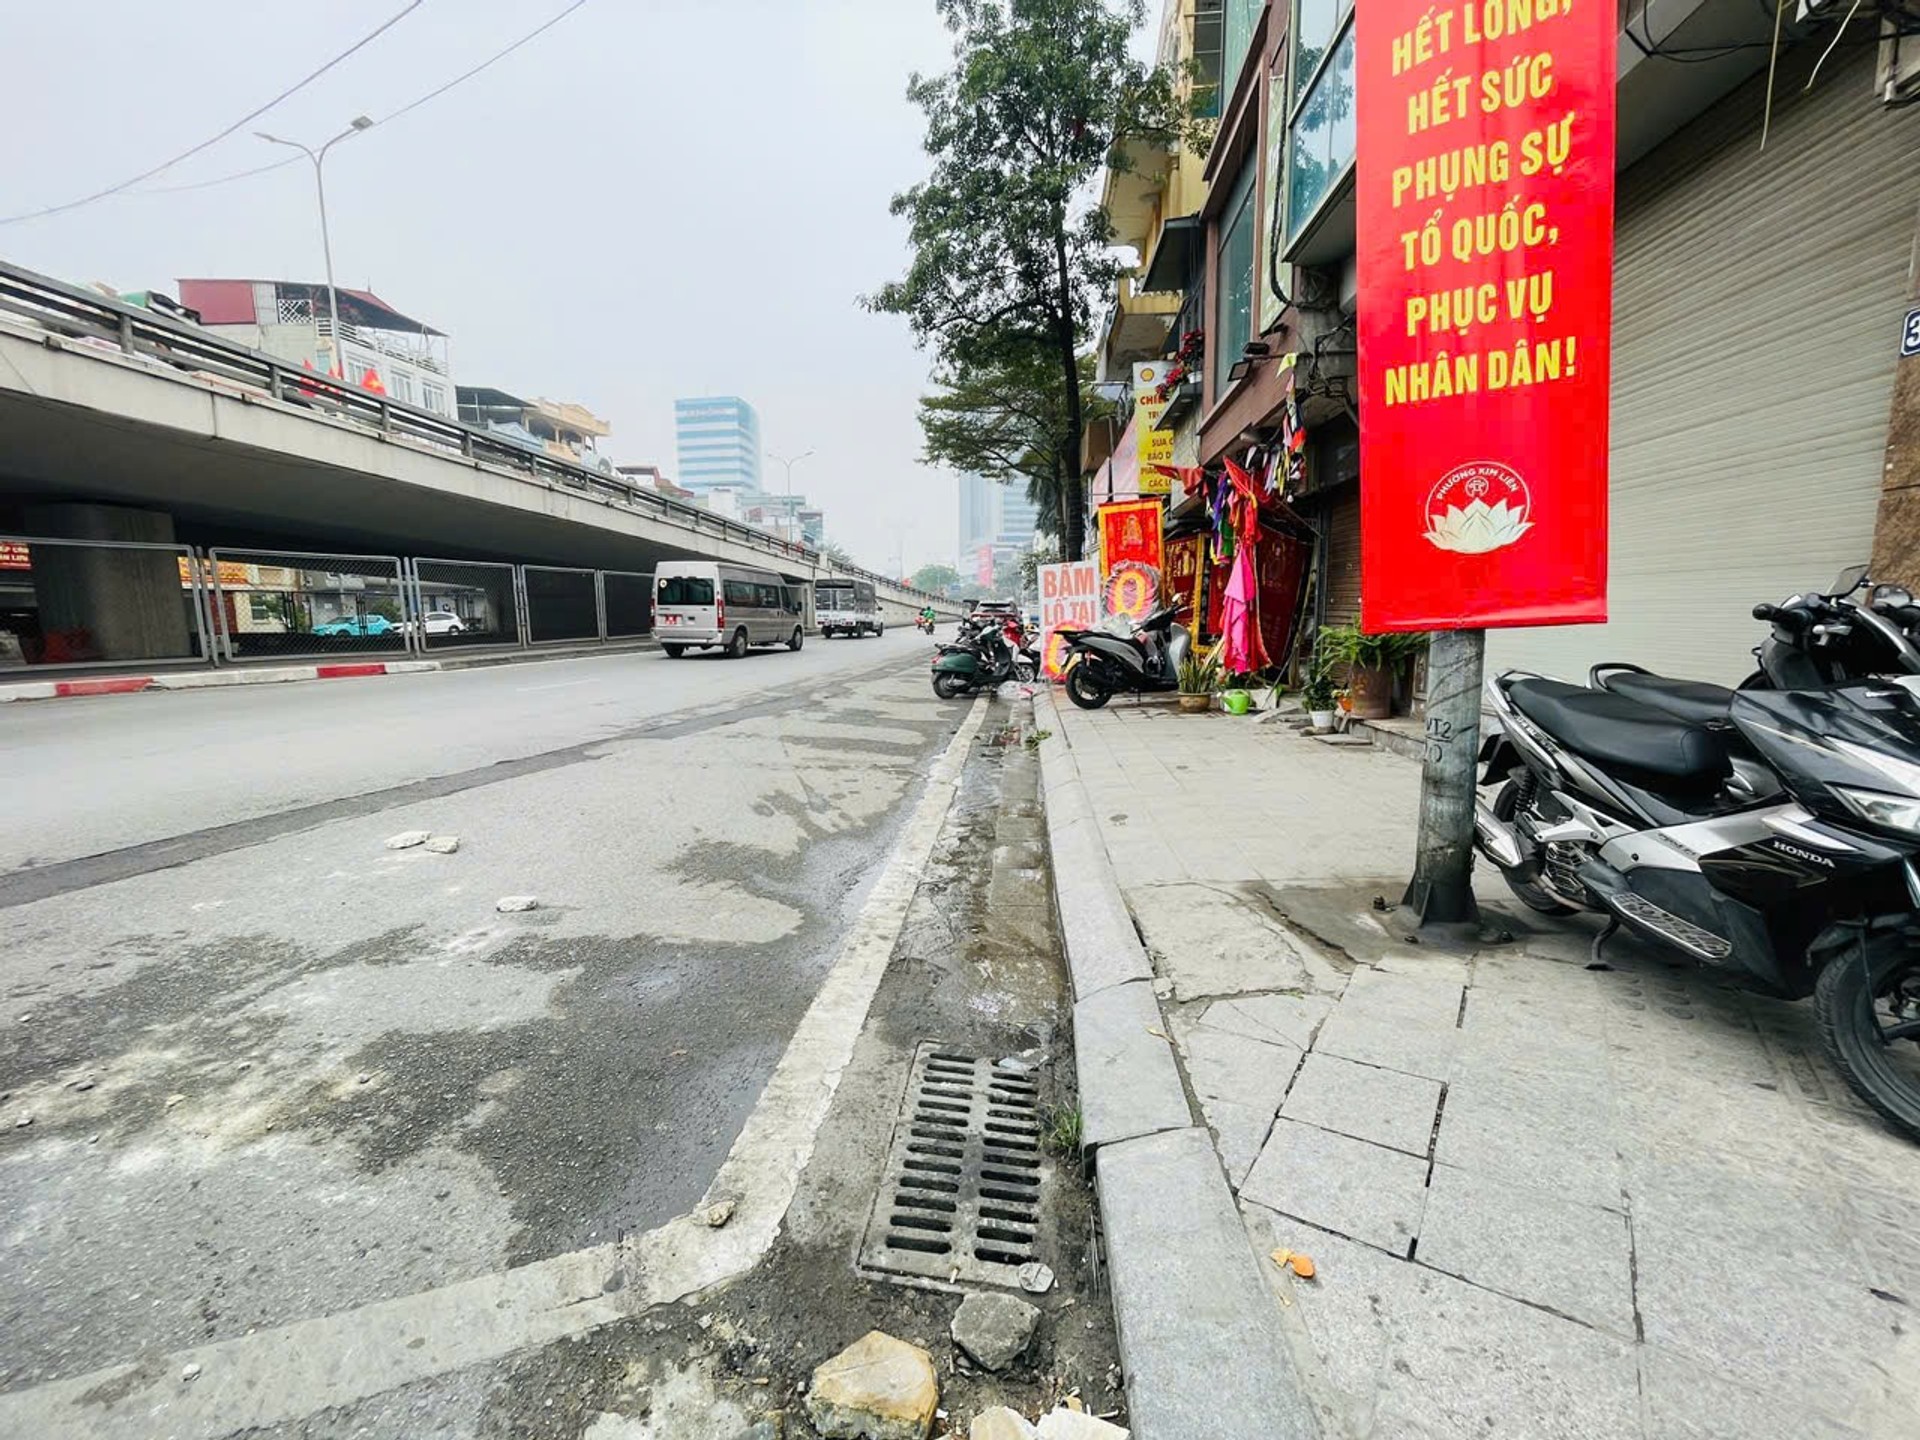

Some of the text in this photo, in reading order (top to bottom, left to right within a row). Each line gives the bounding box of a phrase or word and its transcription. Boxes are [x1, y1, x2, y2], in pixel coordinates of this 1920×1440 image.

[1391, 5, 1454, 77] HẾT
[1408, 52, 1553, 135] HẾT SỨC
[1392, 112, 1575, 208] PHỤNG SỰ
[1401, 194, 1559, 270] TỔ QUỐC,
[1407, 271, 1553, 337] PHỤC VỤ
[1386, 336, 1576, 406] NHÂN DÂN!
[1478, 467, 1499, 477] KIM
[1498, 472, 1519, 492] LIÊN
[1043, 564, 1095, 598] BẤM
[1070, 600, 1096, 625] TAI
[1772, 840, 1836, 869] HONDA
